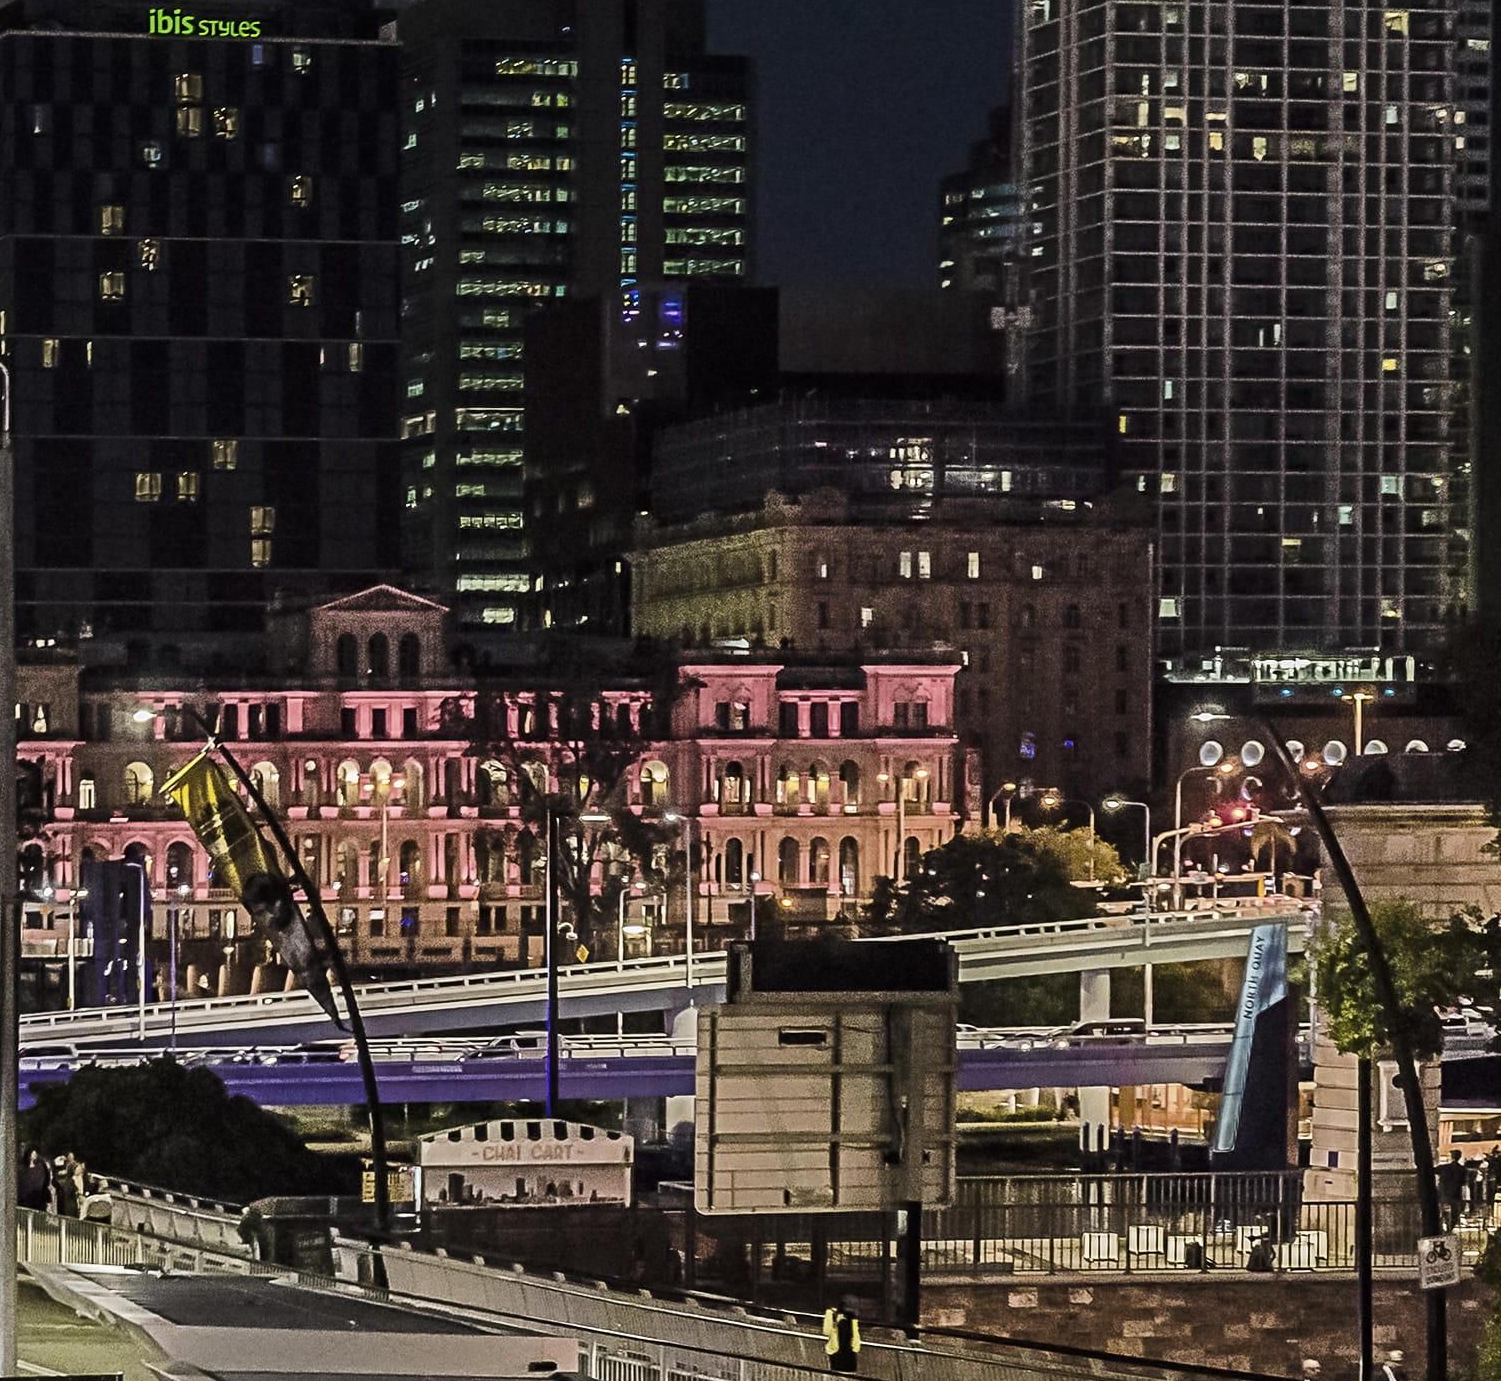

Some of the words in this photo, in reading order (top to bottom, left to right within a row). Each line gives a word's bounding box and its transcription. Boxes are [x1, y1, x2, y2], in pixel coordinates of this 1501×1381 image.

[149, 9, 195, 34] ibis
[1244, 975, 1258, 1019] NORTH
[1253, 936, 1265, 969] QUAY
[483, 1144, 522, 1161] CHAI
[530, 1144, 574, 1161] CART
